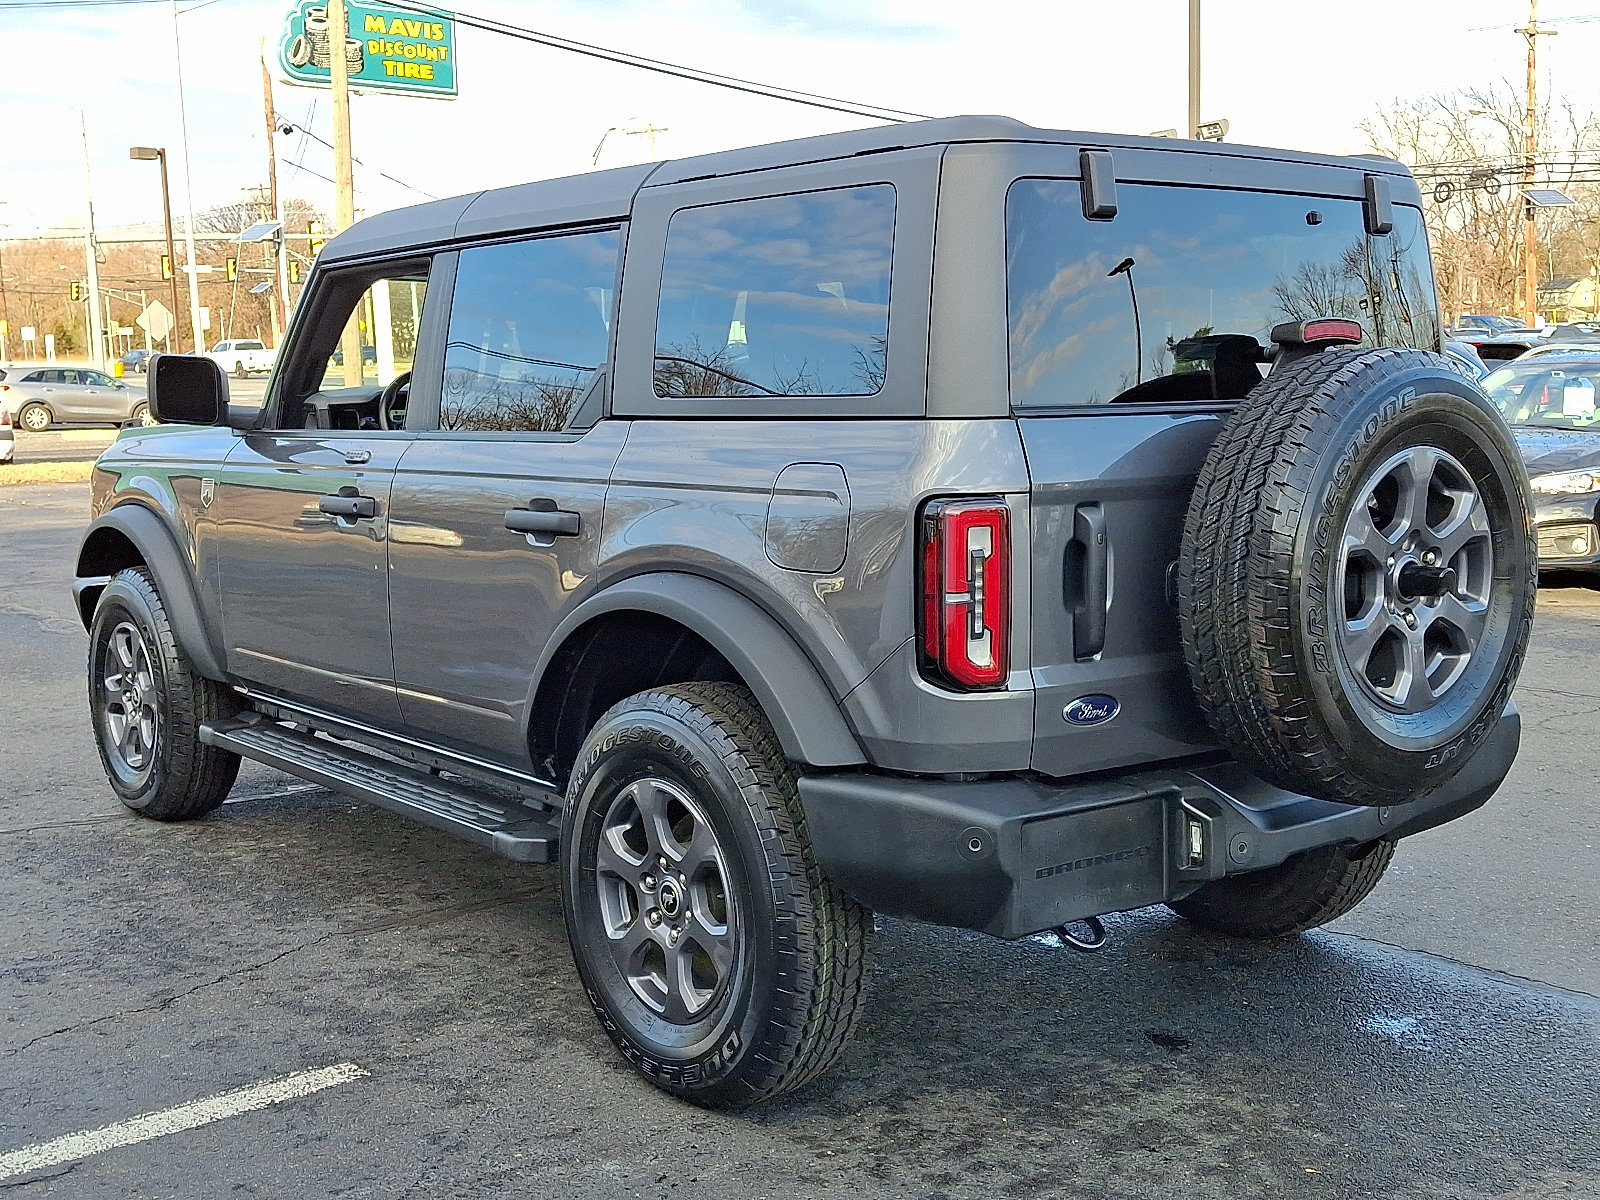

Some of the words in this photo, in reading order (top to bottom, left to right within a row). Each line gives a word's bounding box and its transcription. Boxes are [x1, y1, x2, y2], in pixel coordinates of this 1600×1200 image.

[364, 14, 444, 41] MAVIS
[367, 38, 447, 62] DISCOUNT
[382, 60, 434, 80] TIRE
[1302, 386, 1418, 675] BRIDGESTONE
[1076, 701, 1111, 720] Ford
[1036, 846, 1149, 880] BRONCO
